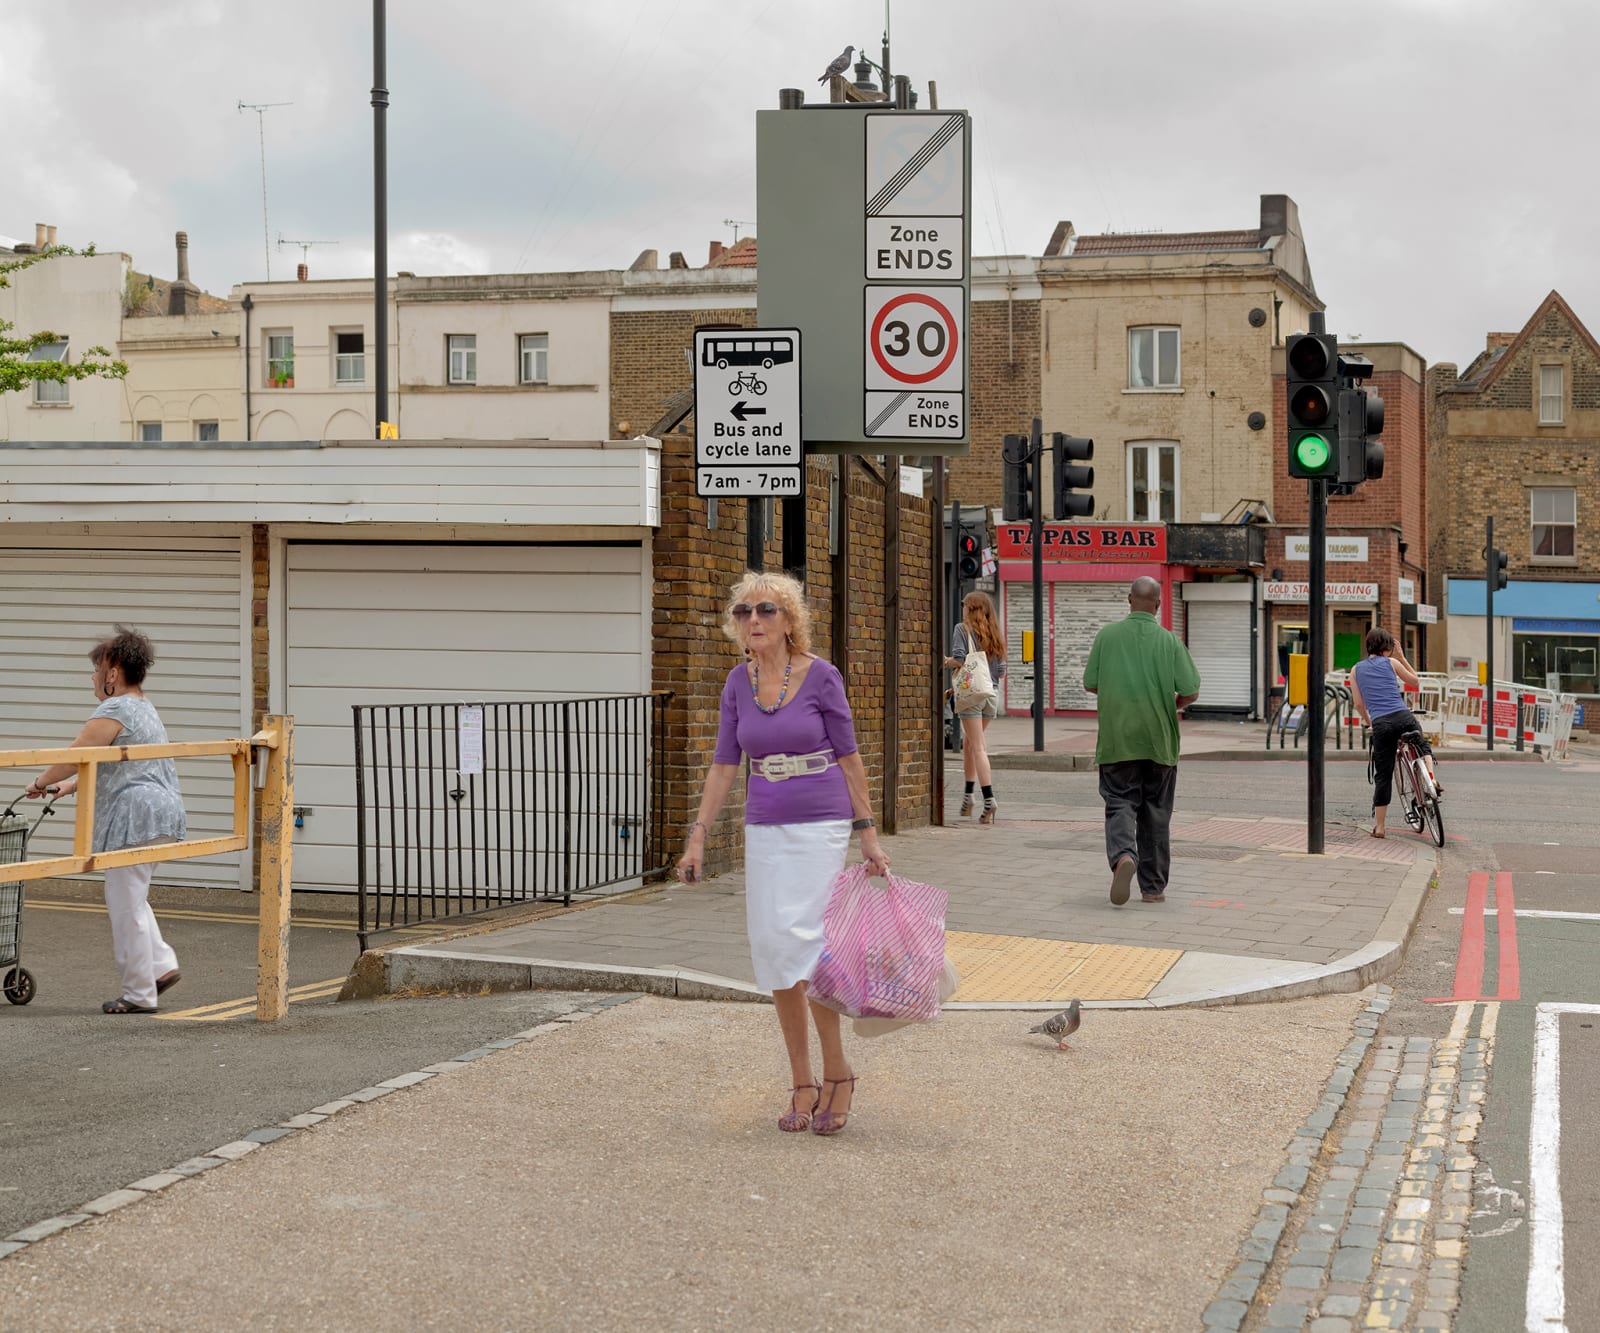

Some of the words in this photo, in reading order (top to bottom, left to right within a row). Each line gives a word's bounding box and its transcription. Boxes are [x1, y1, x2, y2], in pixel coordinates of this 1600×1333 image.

[890, 225, 939, 242] Zone
[877, 249, 953, 270] ENDS
[884, 320, 946, 358] 30
[917, 397, 950, 409] Zone
[714, 422, 746, 437] Bus
[751, 421, 783, 437] and
[908, 414, 959, 429] ENDS
[705, 441, 750, 459] cycle
[756, 441, 792, 456] lane
[703, 473, 740, 488] 7am
[758, 473, 797, 491] 7pm
[1101, 530, 1158, 547] BAR
[1328, 544, 1359, 553] TAILORING
[1268, 584, 1290, 594] GOLD
[1325, 585, 1372, 595] AILORING
